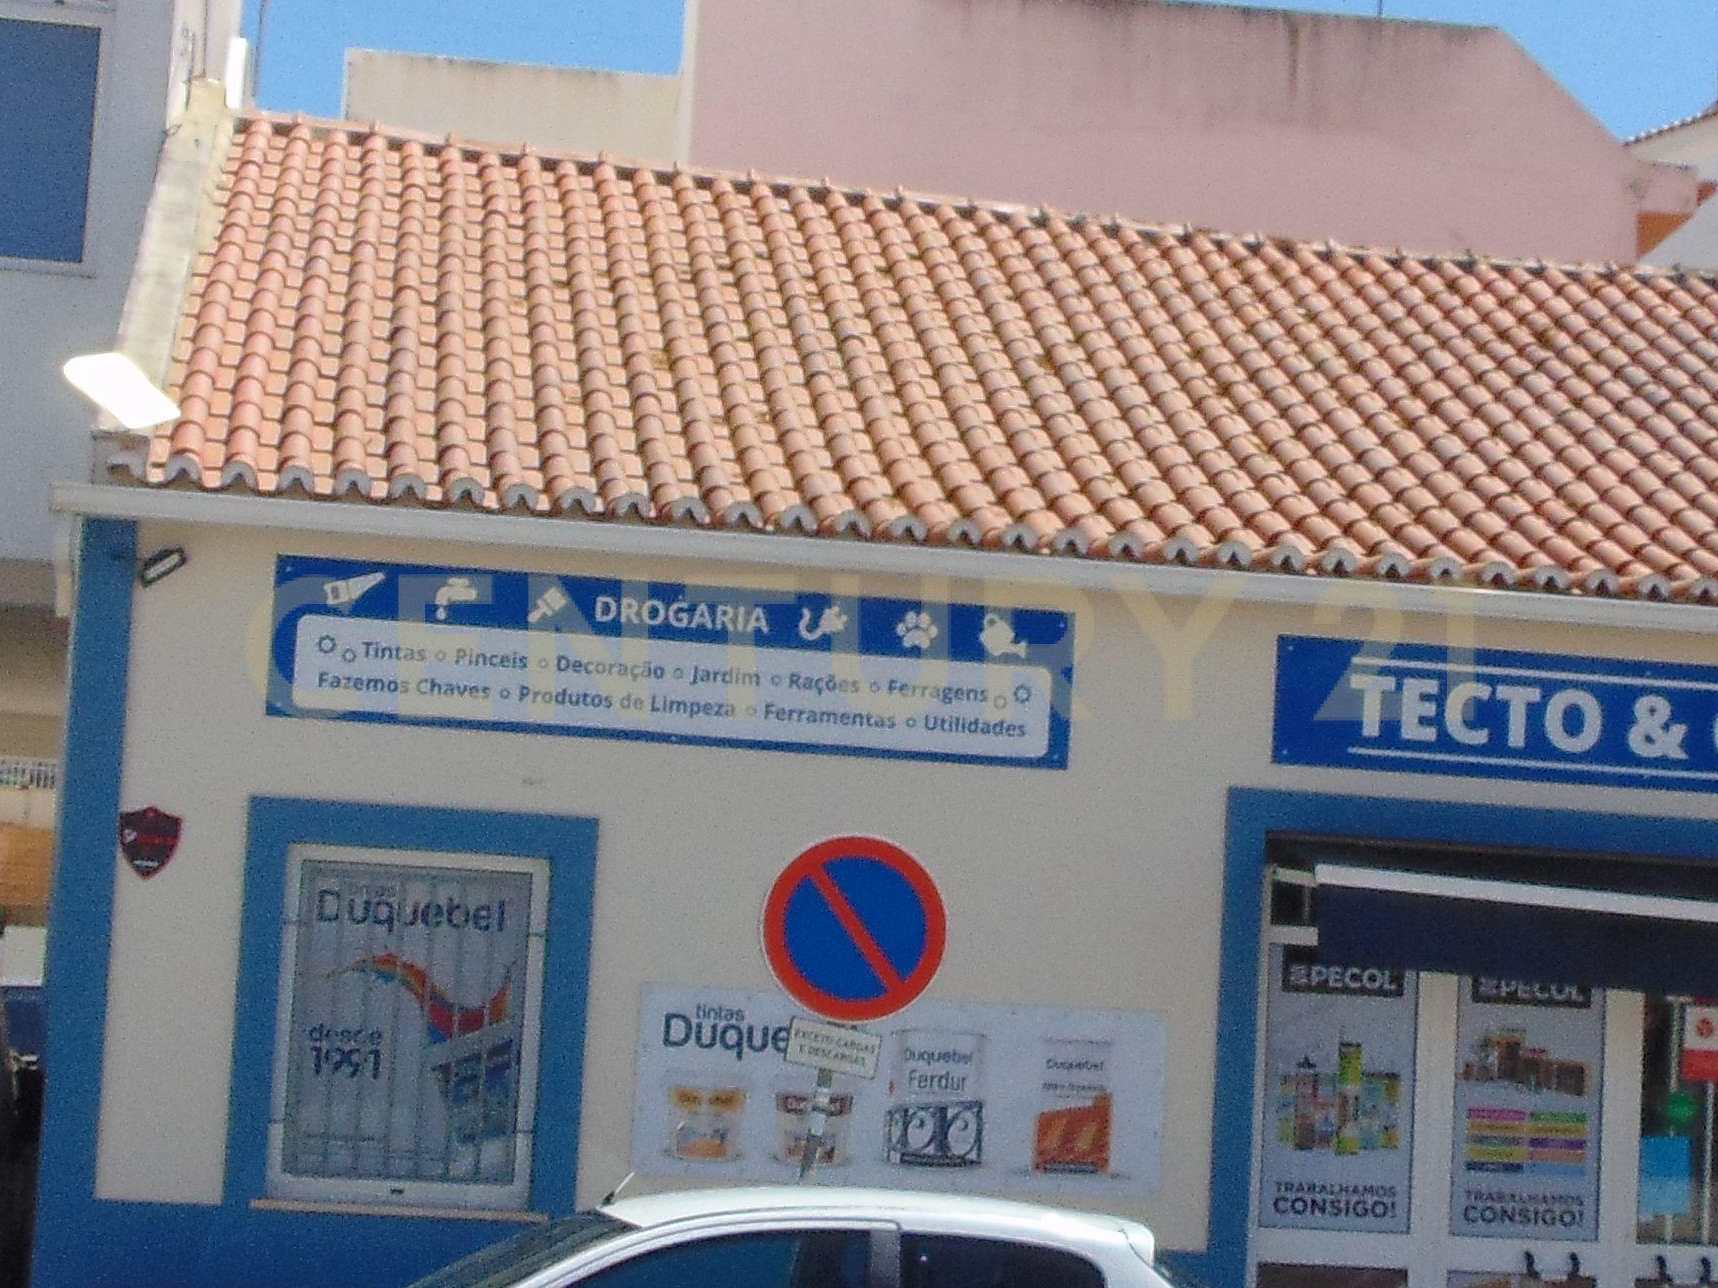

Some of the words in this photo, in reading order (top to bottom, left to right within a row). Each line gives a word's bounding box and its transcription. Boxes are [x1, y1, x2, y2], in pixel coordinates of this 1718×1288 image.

[594, 595, 770, 635] DROGARIA
[361, 641, 426, 663] Tintas
[453, 647, 529, 670] Pinceis
[555, 655, 665, 682] Decoração
[689, 665, 762, 688] Jardim
[788, 673, 860, 697] Rações
[886, 678, 989, 706] Ferragens
[317, 671, 411, 695] Fazemos
[416, 677, 491, 700] Chaves
[518, 685, 614, 710] Produtos
[619, 690, 644, 712] de
[650, 694, 736, 720] Limpeza
[763, 703, 897, 731] Ferramentas
[924, 713, 1027, 739] Utilidades
[1349, 672, 1603, 755] TECTO
[1626, 697, 1688, 762] &
[1310, 965, 1397, 992] PECOL
[695, 1002, 746, 1022] tintas
[662, 1011, 791, 1061] Duque
[907, 1069, 969, 1092] Ferdur
[1274, 1180, 1397, 1200] TRABALHAMOS
[1463, 1188, 1585, 1208] TRABALHAMOS
[1272, 1195, 1397, 1219] CONSIGO!
[1462, 1205, 1585, 1228] CONSIGO!
